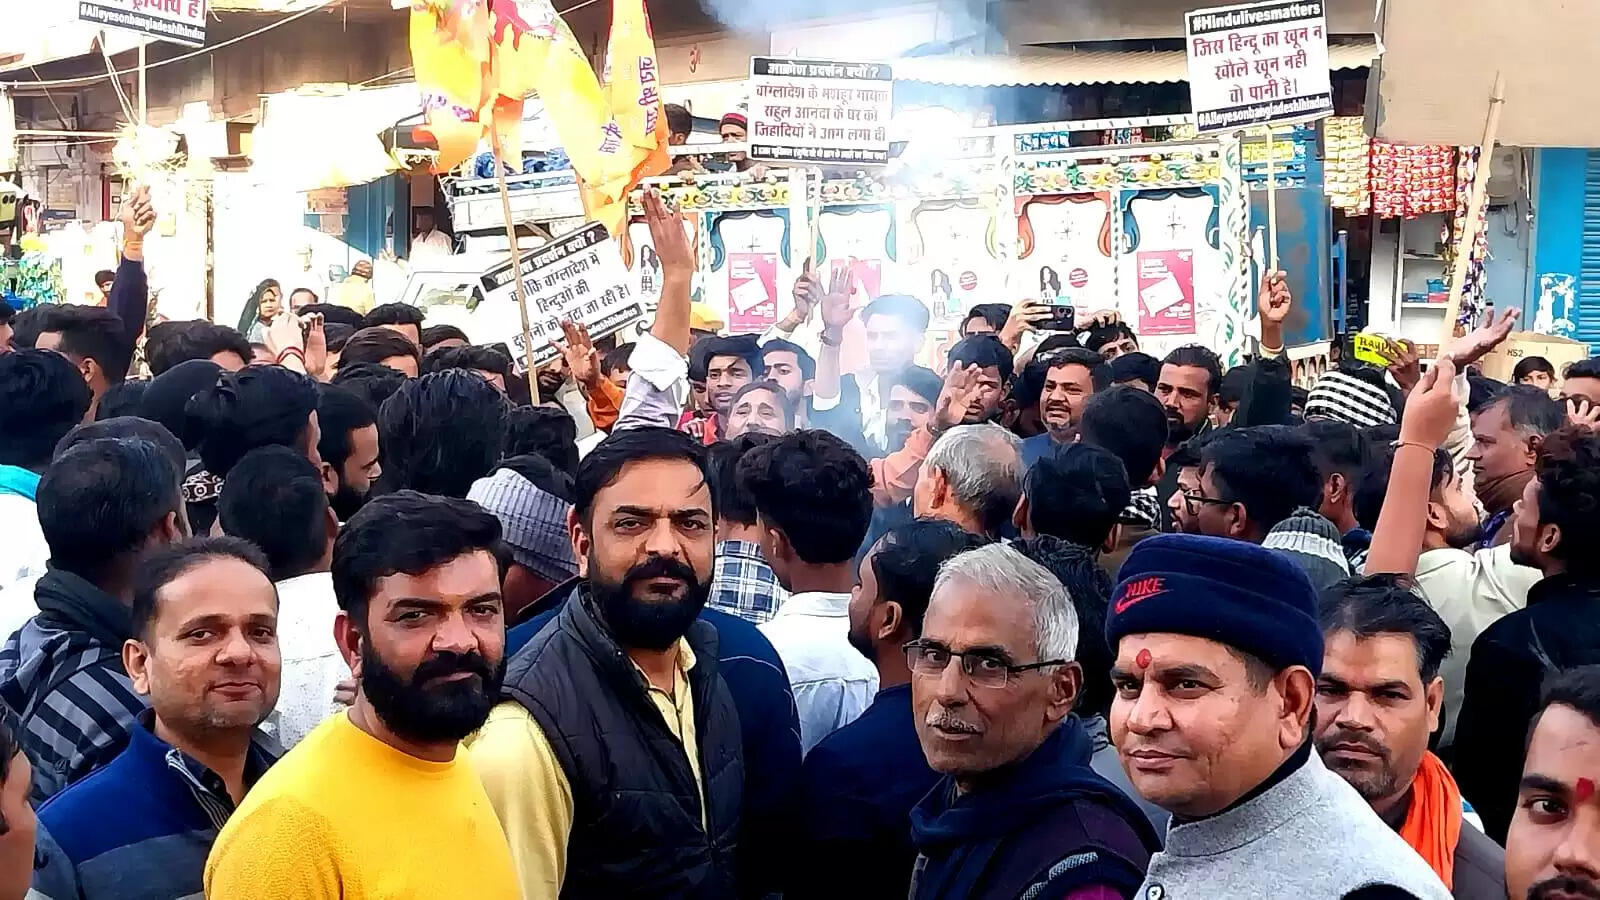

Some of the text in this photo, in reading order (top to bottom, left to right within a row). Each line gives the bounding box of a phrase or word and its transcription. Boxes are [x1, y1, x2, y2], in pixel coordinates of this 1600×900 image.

[1192, 4, 1321, 32] #Hindulivesmatters
[1193, 25, 1322, 57] जिस हिन्दू का खून न
[1214, 58, 1249, 80] खौले
[1254, 57, 1279, 79] खून
[1249, 79, 1279, 101] पानी
[764, 105, 791, 122] राहुल
[754, 122, 804, 138] जिहादियों
[848, 129, 870, 141] लगा
[574, 279, 590, 297] की
[583, 298, 599, 314] जा
[599, 289, 617, 306] रही
[1126, 577, 1166, 598] NIKE
